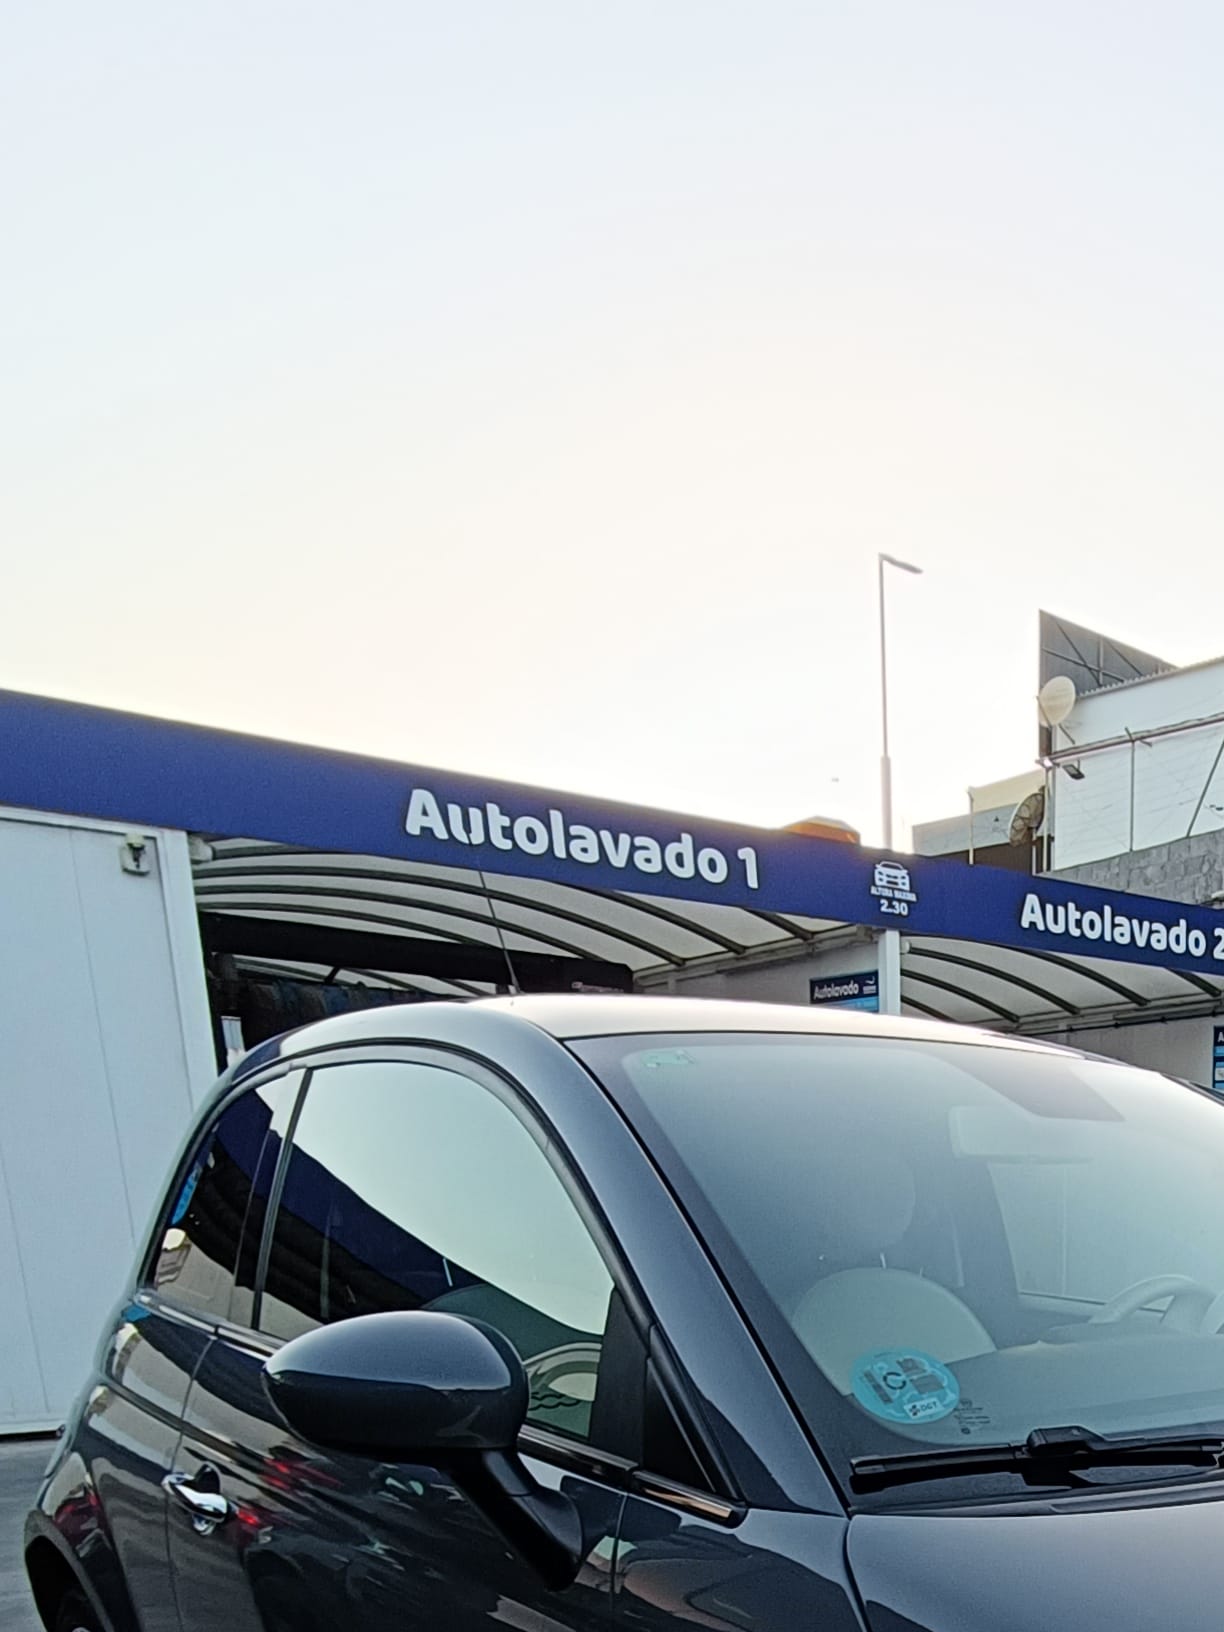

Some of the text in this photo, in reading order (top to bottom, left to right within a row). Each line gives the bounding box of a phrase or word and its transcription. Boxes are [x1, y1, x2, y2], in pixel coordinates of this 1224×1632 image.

[405, 788, 759, 889] Autolavado 1
[880, 898, 908, 916] 2.30
[1021, 893, 1206, 957] Autolavado
[813, 980, 859, 1000] Autolavado
